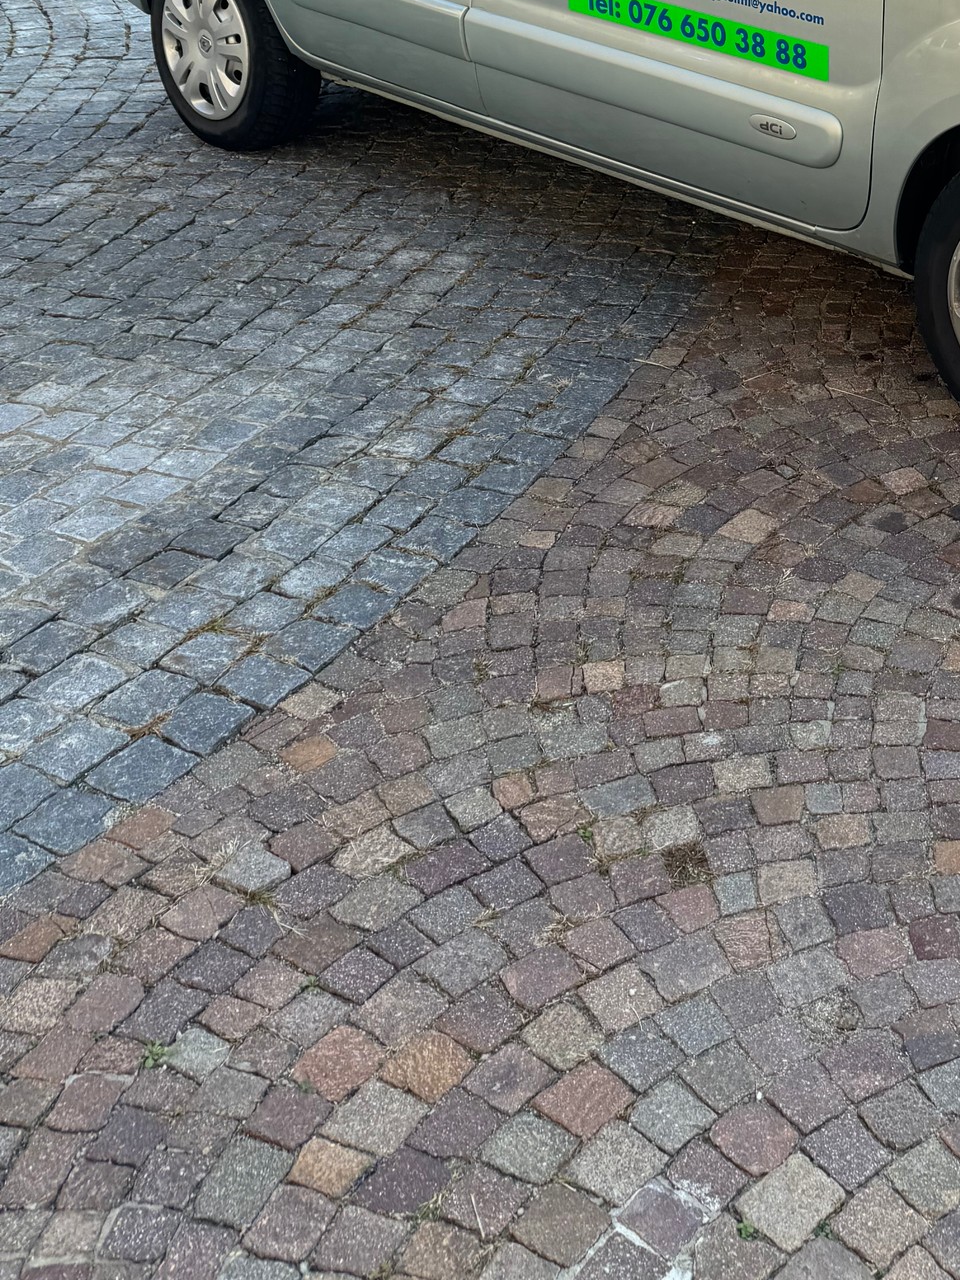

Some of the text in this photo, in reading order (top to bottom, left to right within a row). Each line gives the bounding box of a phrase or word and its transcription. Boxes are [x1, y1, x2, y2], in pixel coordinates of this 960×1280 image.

[628, 0, 673, 32] 076
[680, 14, 726, 47] 650
[735, 28, 766, 58] 38
[775, 38, 807, 70] 88
